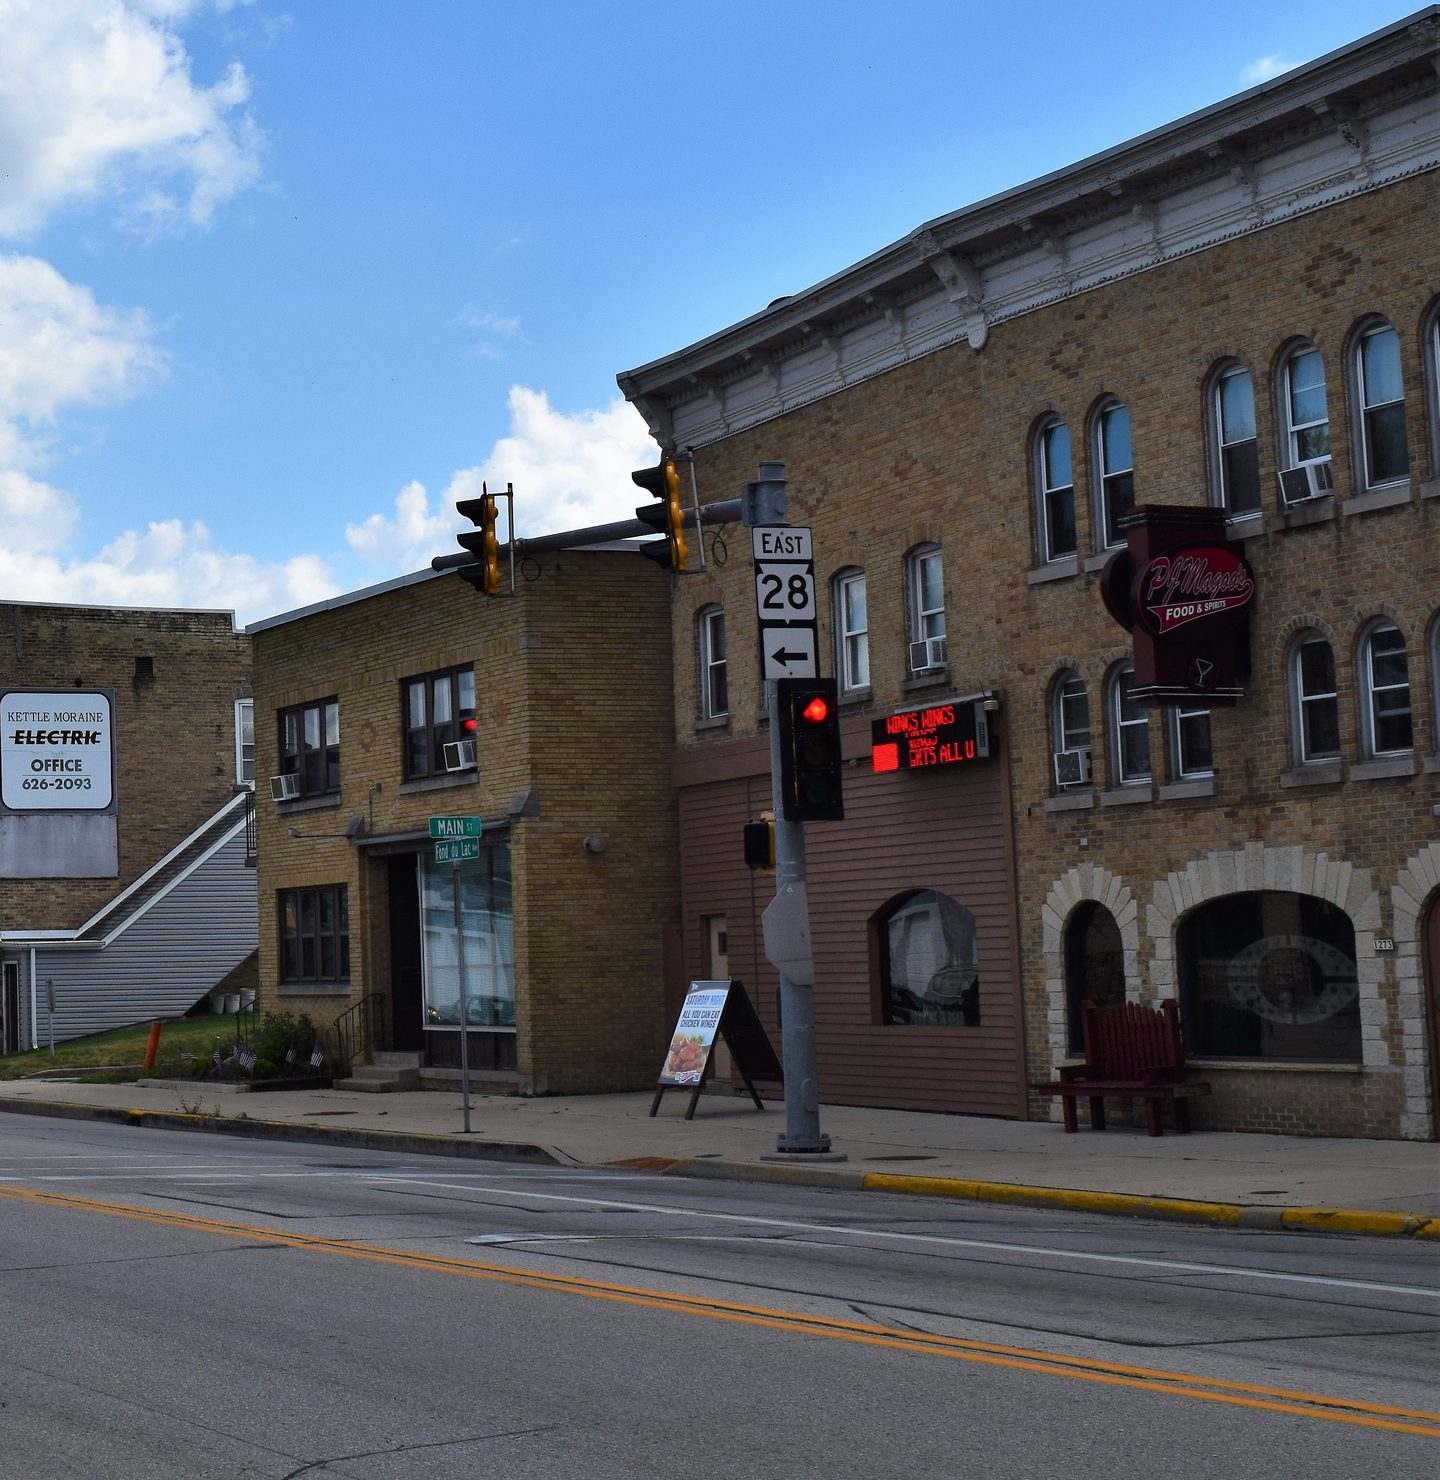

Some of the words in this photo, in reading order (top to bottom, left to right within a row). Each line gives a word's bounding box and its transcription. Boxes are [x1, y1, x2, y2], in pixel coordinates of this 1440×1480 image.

[762, 533, 802, 554] EAST
[761, 574, 809, 610] 28
[1165, 605, 1195, 621] FOOD
[1196, 604, 1202, 613] &
[1204, 600, 1226, 612] SPIRITS
[7, 712, 50, 722] KETTLE
[53, 712, 104, 722] MORAINE
[921, 705, 955, 728] WINGS
[10, 730, 102, 745] ELECTRIC
[940, 742, 964, 763] ALL
[965, 740, 975, 759] U
[30, 759, 82, 772] OFFICE
[22, 778, 92, 790] 626-2093
[437, 819, 464, 835] MAIN
[435, 844, 449, 860] Fond
[451, 841, 459, 858] du
[461, 841, 472, 857] Lac
[1375, 940, 1392, 949] 1273
[686, 995, 711, 1005] SATURDAY
[709, 995, 726, 1005] NIGHT
[682, 1010, 692, 1019] ALL
[691, 1010, 701, 1019] YOU
[700, 1010, 711, 1019] CAN
[710, 1010, 720, 1019] EAT
[680, 1019, 700, 1028] CHICKEN
[700, 1019, 716, 1028] WINGS
